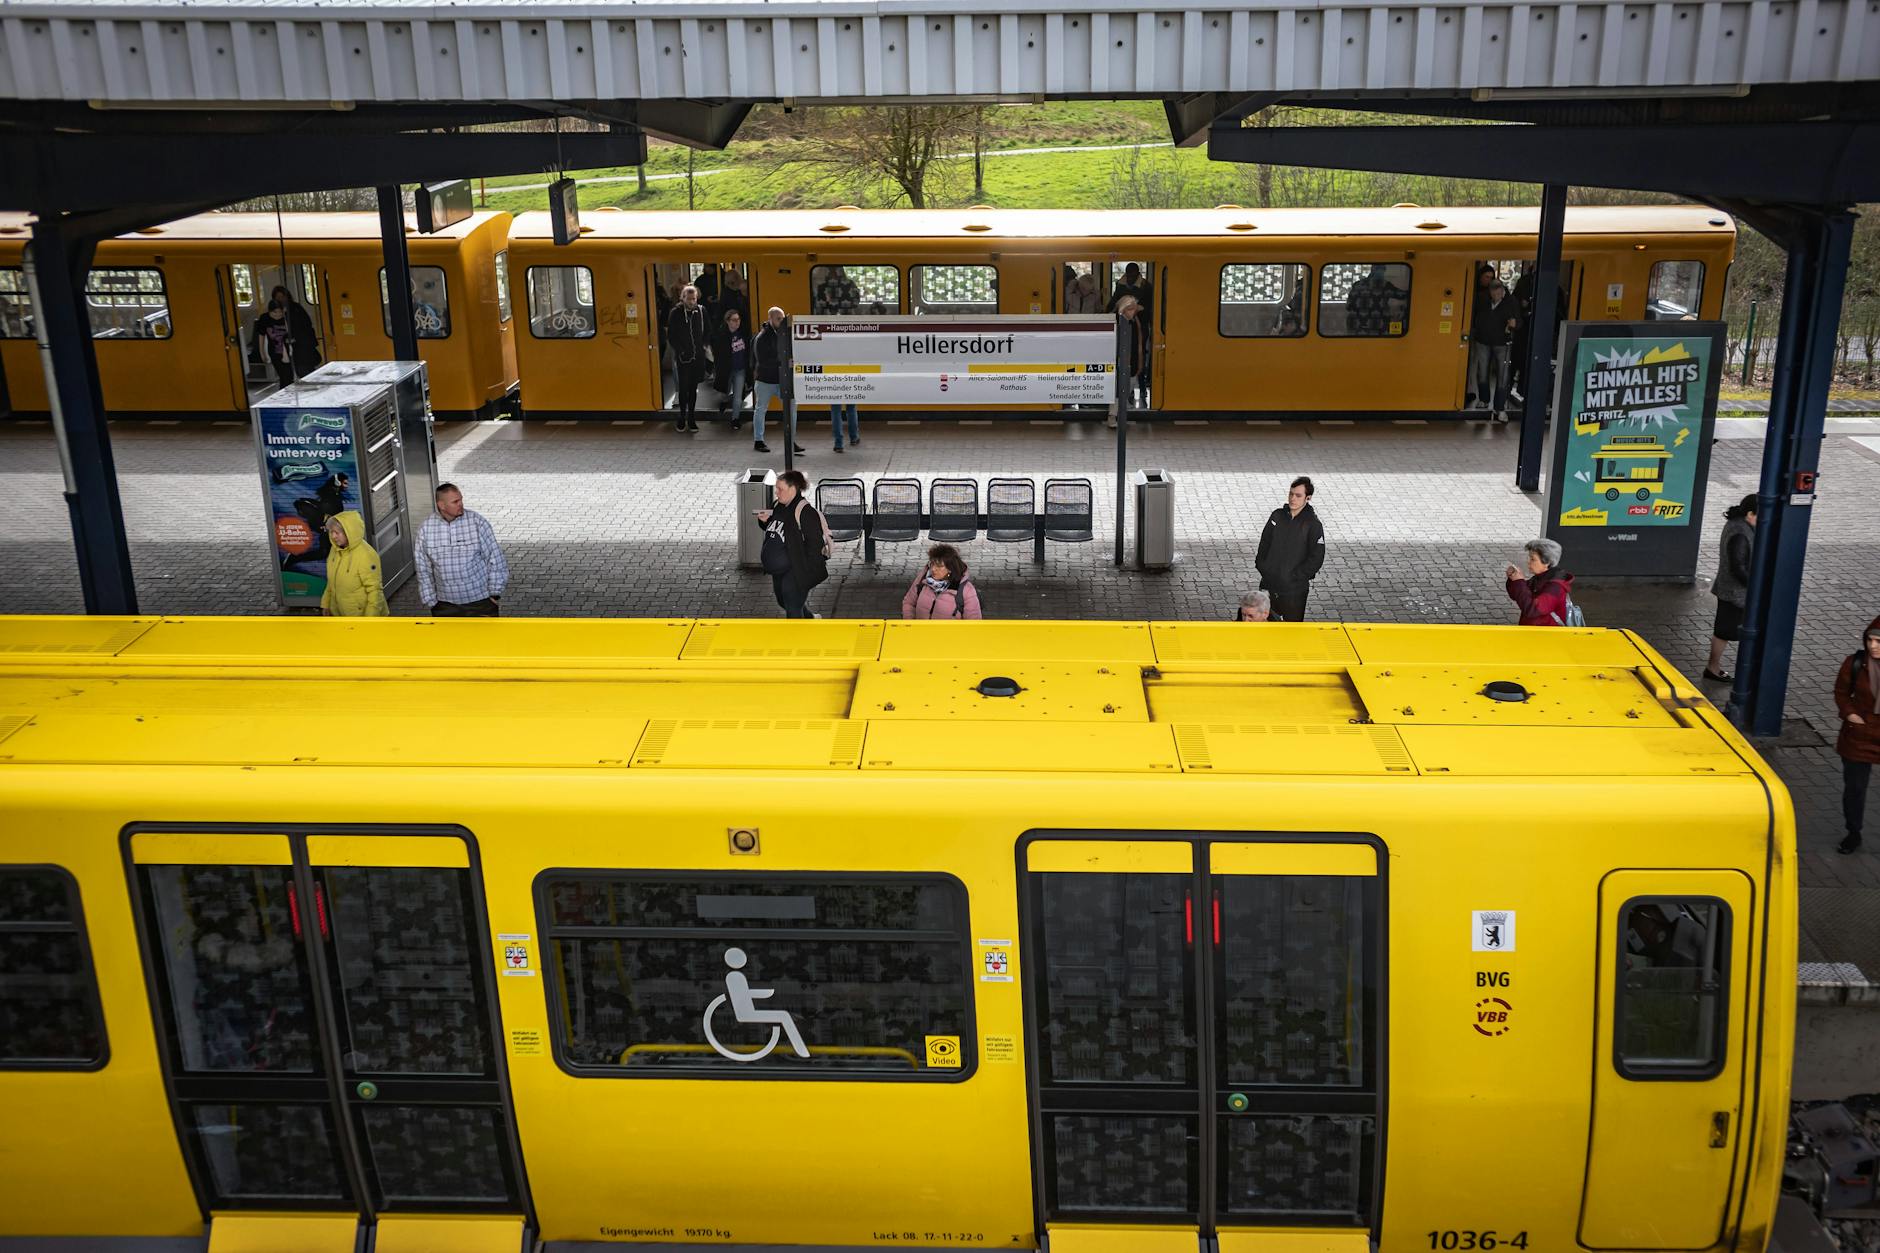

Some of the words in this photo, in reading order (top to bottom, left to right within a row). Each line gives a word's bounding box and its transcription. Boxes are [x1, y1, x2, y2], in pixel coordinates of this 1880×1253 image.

[795, 324, 820, 338] U5
[831, 324, 880, 332] Hauptbahnhof
[897, 334, 1014, 354] Hellersdorf
[804, 375, 866, 383] Nelly-Sachs-Straße
[1586, 368, 1653, 390] EINMAL
[1657, 364, 1698, 384] HITS
[805, 384, 852, 392] Tangermünder
[1586, 389, 1618, 409] MIT
[1622, 384, 1681, 406] ALLES!
[300, 414, 345, 428] Airwaves
[1580, 411, 1597, 422] IT'S
[267, 433, 311, 444] Immer
[315, 432, 350, 444] fresh
[269, 448, 343, 460] unterwegs
[1629, 506, 1648, 514] rbb
[1652, 505, 1685, 516] FRITZ
[1476, 971, 1510, 987] BVG
[1477, 1011, 1508, 1022] VBB
[932, 1057, 956, 1065] Video
[600, 1227, 674, 1237] Eigengewicht
[873, 1231, 898, 1240] Lack
[1427, 1230, 1529, 1250] 1036-4
